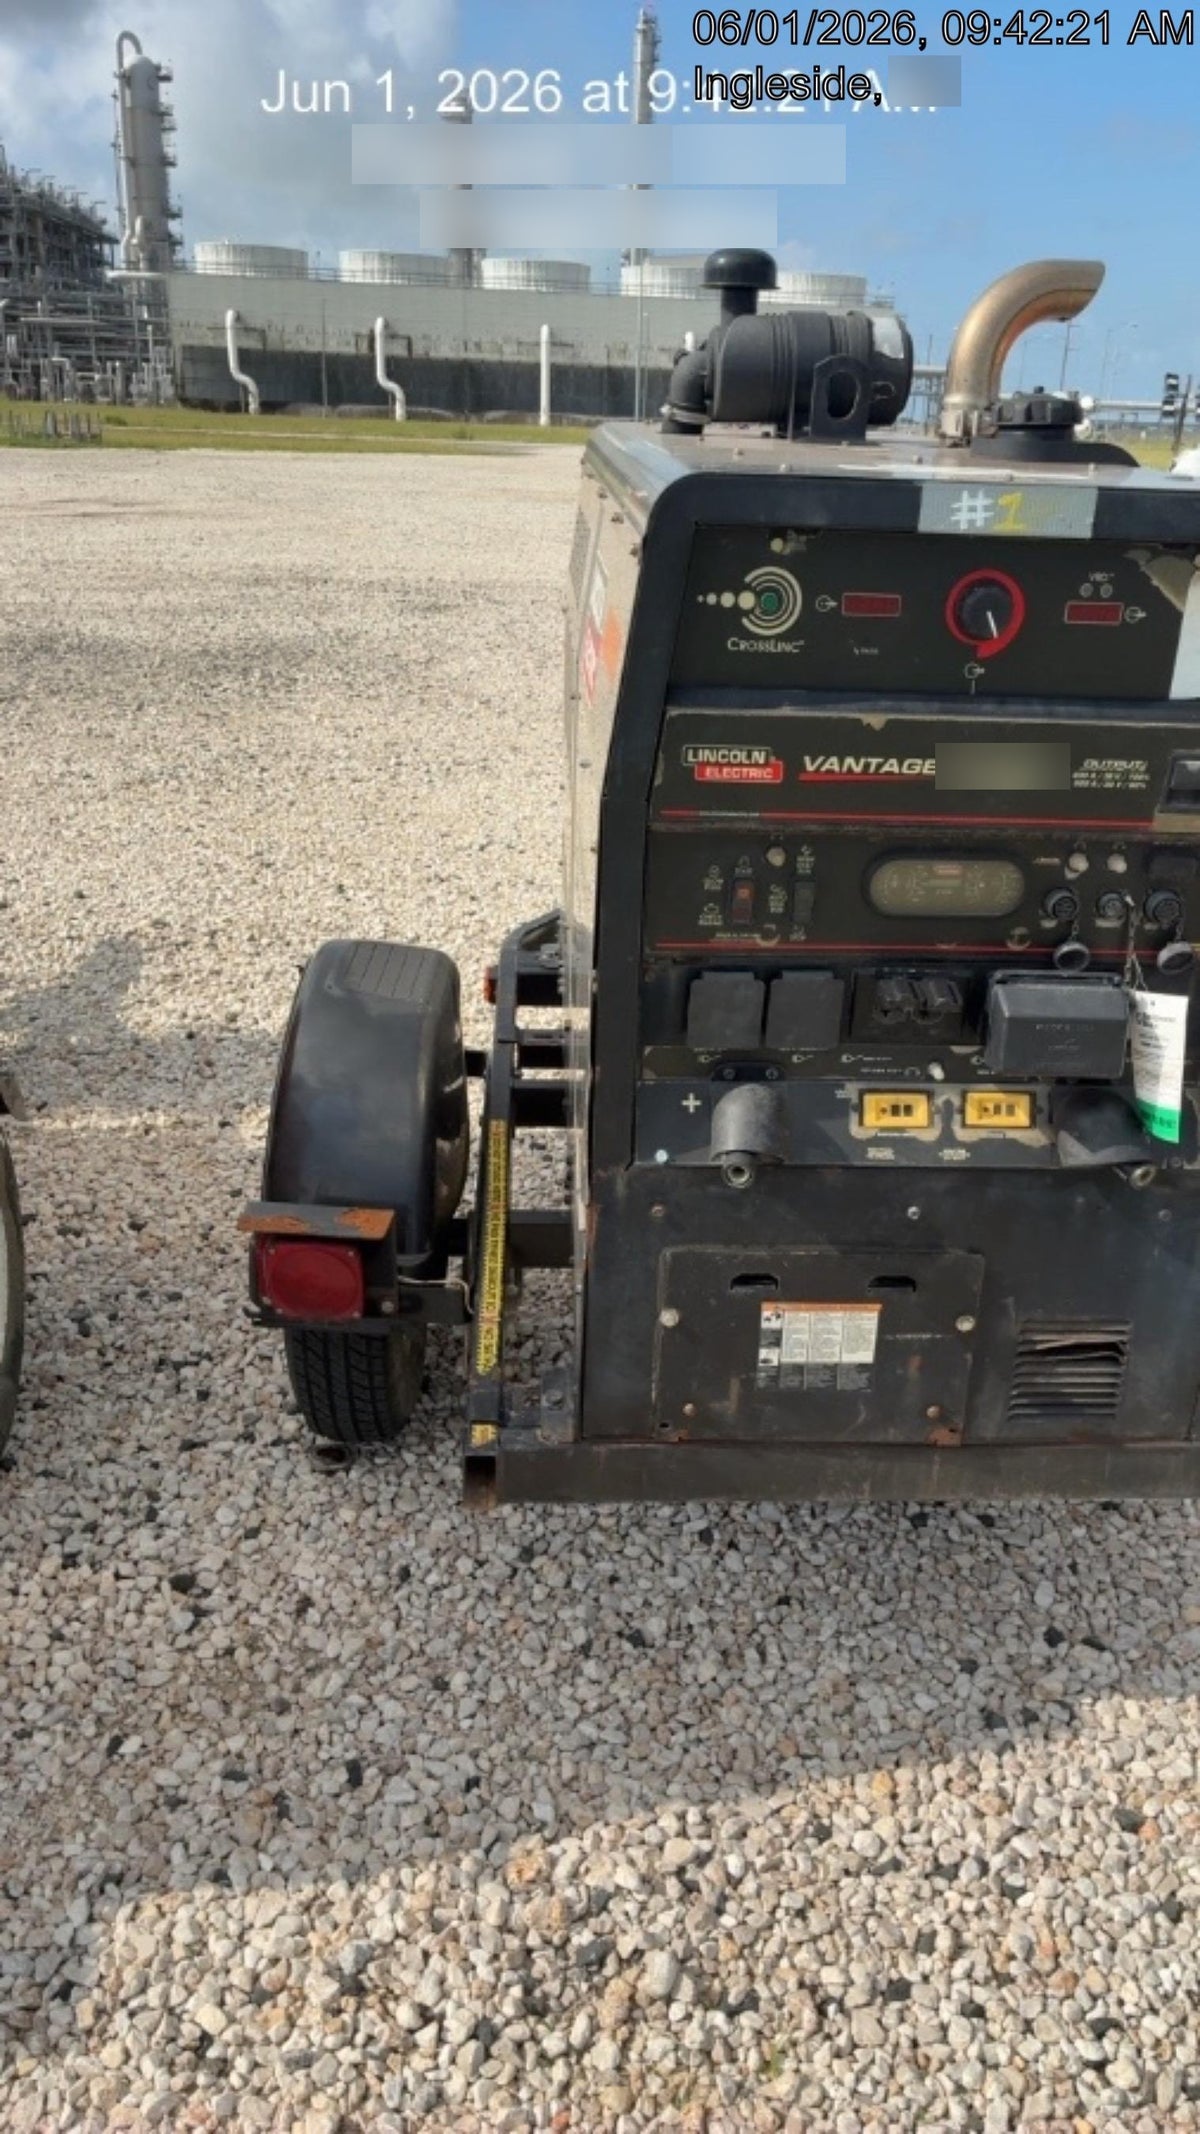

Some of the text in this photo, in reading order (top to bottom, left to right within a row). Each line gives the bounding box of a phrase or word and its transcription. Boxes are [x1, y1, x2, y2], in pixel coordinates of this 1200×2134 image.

[951, 489, 1026, 531] #1
[686, 749, 767, 765] LINCOLN
[803, 755, 936, 776] VANTAGE
[705, 766, 774, 779] ELECTRIC
